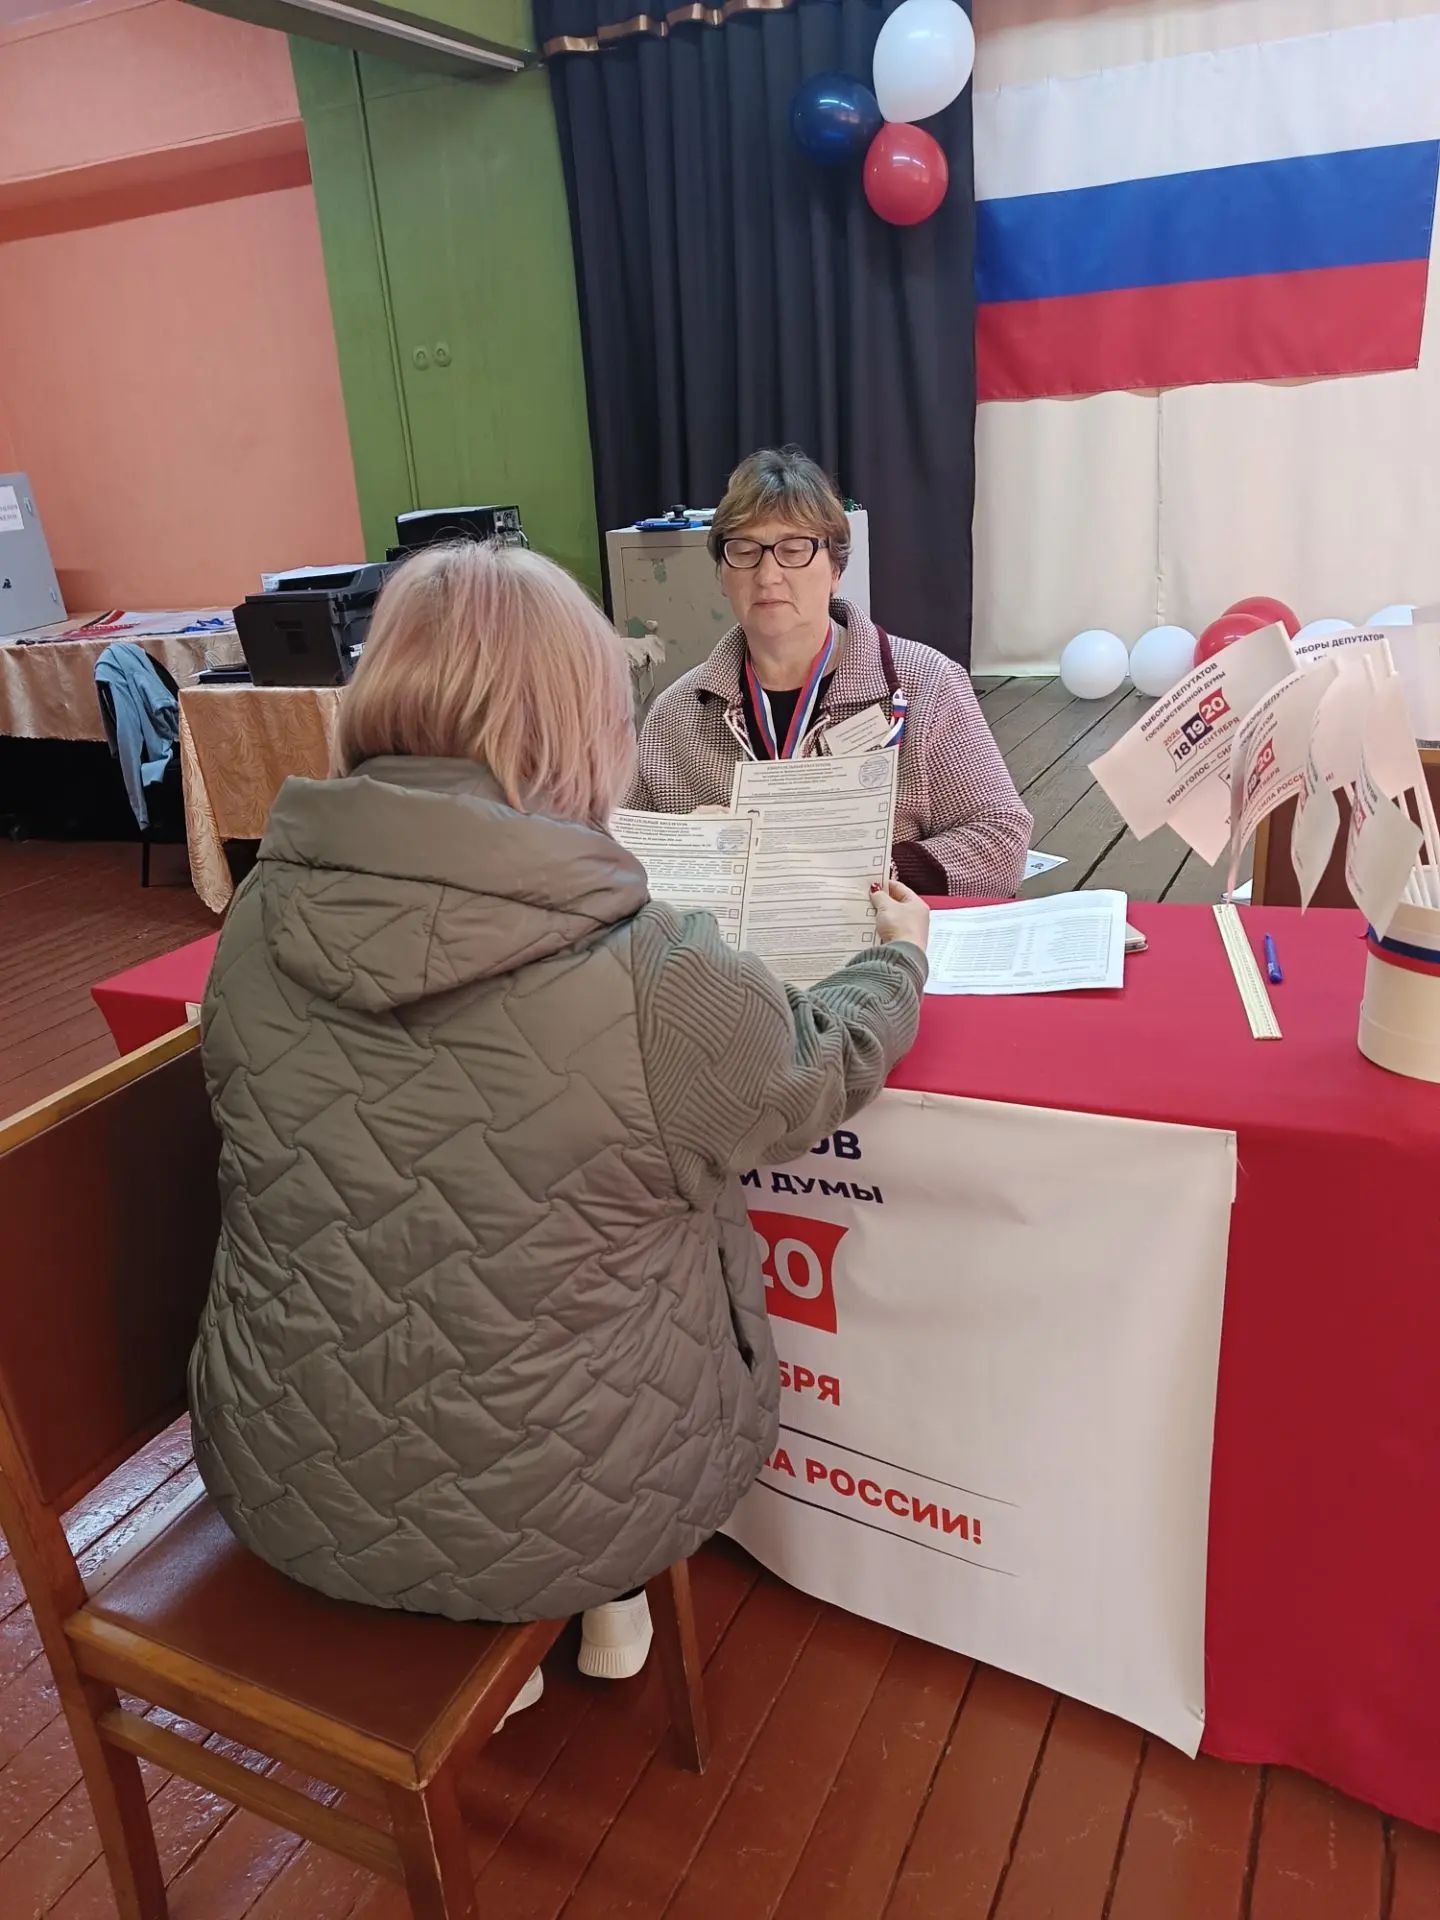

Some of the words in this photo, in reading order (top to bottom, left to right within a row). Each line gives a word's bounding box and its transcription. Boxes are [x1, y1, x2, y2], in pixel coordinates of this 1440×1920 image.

[1140, 700, 1171, 732] ВЫБОРЫ
[1172, 662, 1218, 703] ДЕПУТАТОВ
[1145, 686, 1203, 742] ГОСУДАРСТВЕННОЙ
[1203, 671, 1226, 690] ДУМЫ
[1174, 741, 1191, 760] 18
[1186, 720, 1205, 740] 19
[1201, 696, 1225, 719] 20
[1198, 716, 1240, 750] СЕНТЯБРЯ
[1167, 785, 1186, 805] ТВОЙ
[1186, 763, 1210, 787] ГОЛОС
[1217, 744, 1233, 759] СИЛ
[771, 1172, 884, 1204] ДУМЫ
[805, 1458, 982, 1545] РОССИИ!
